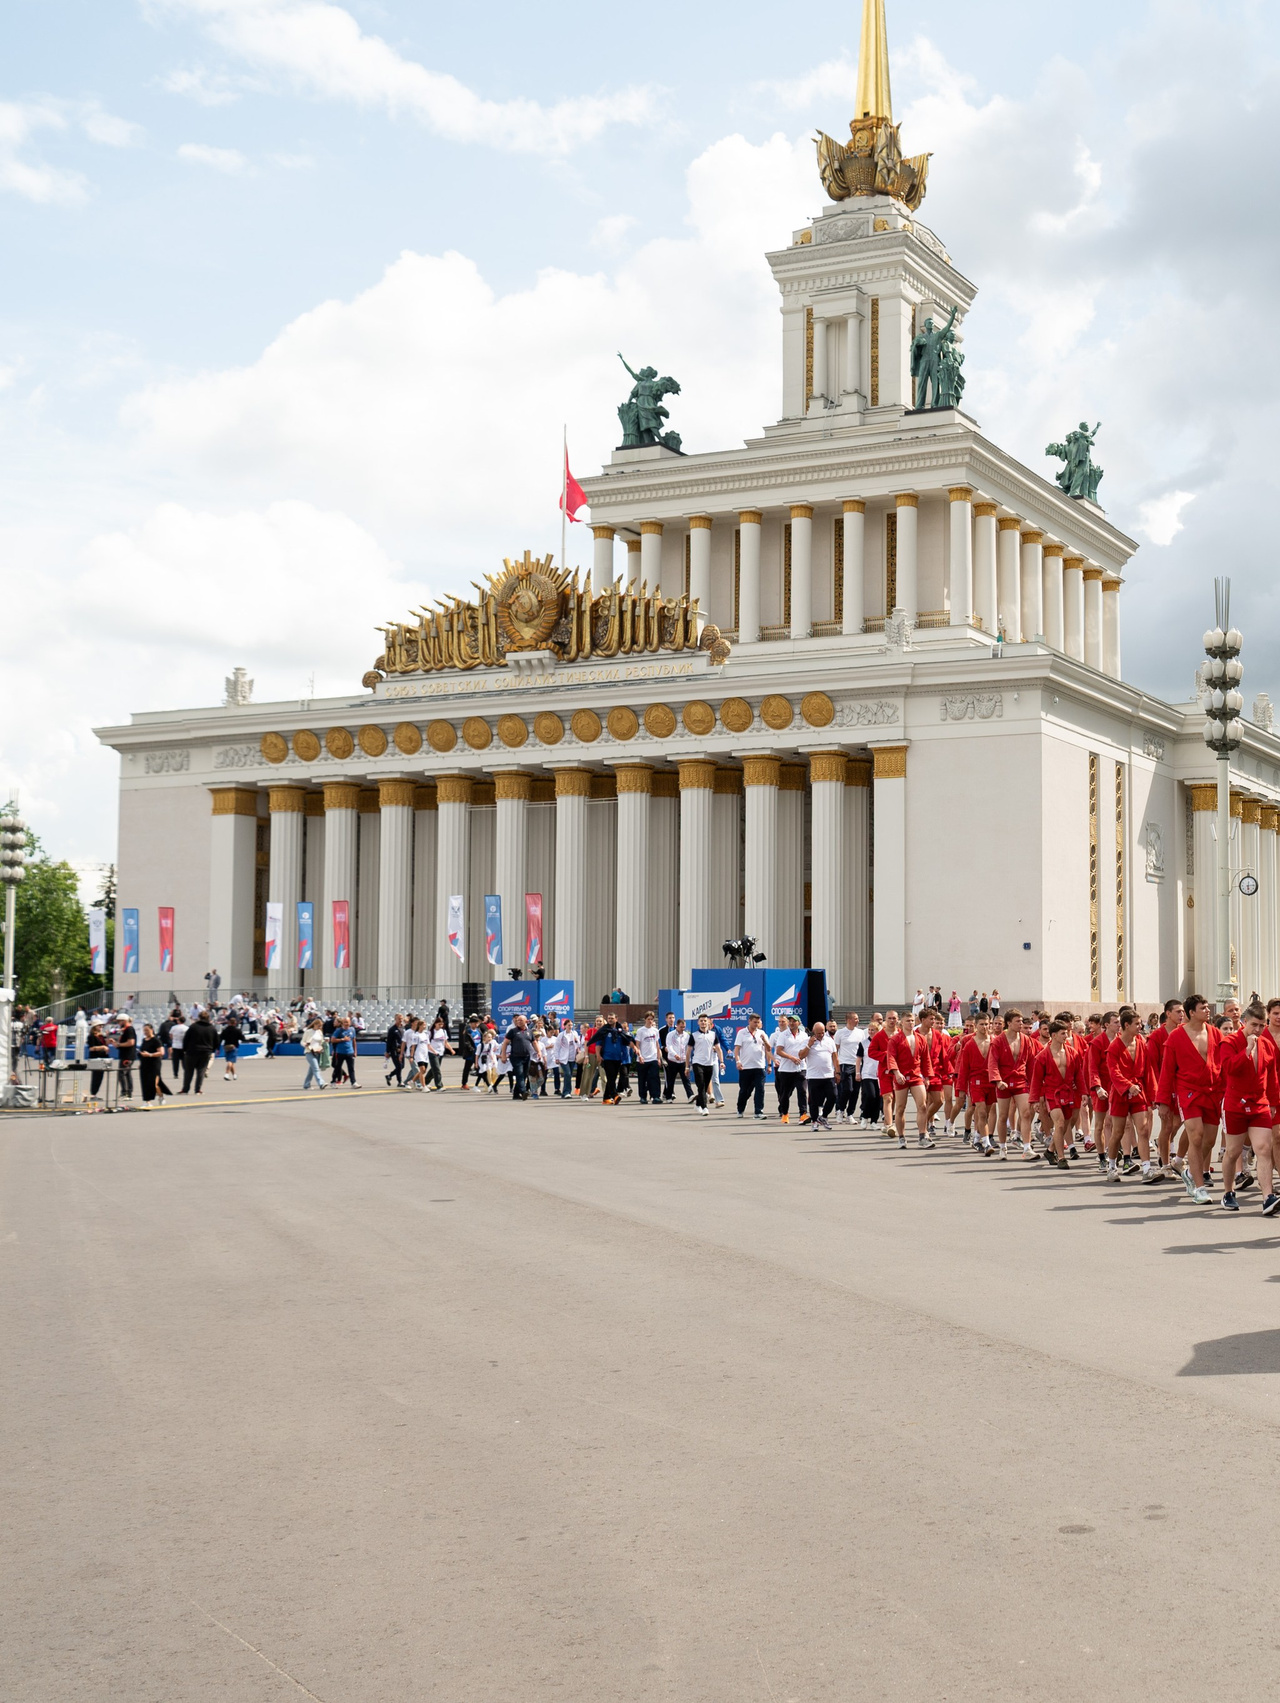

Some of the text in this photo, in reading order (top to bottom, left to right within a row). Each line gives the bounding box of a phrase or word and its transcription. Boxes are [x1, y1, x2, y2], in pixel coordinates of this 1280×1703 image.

[385, 662, 694, 697] СОЮЗ СОВЕТСКИХ СОЦИАЛИСТИЧЕСКИХ РЕСПУБЛИК
[691, 999, 712, 1018] КАРАТЭ
